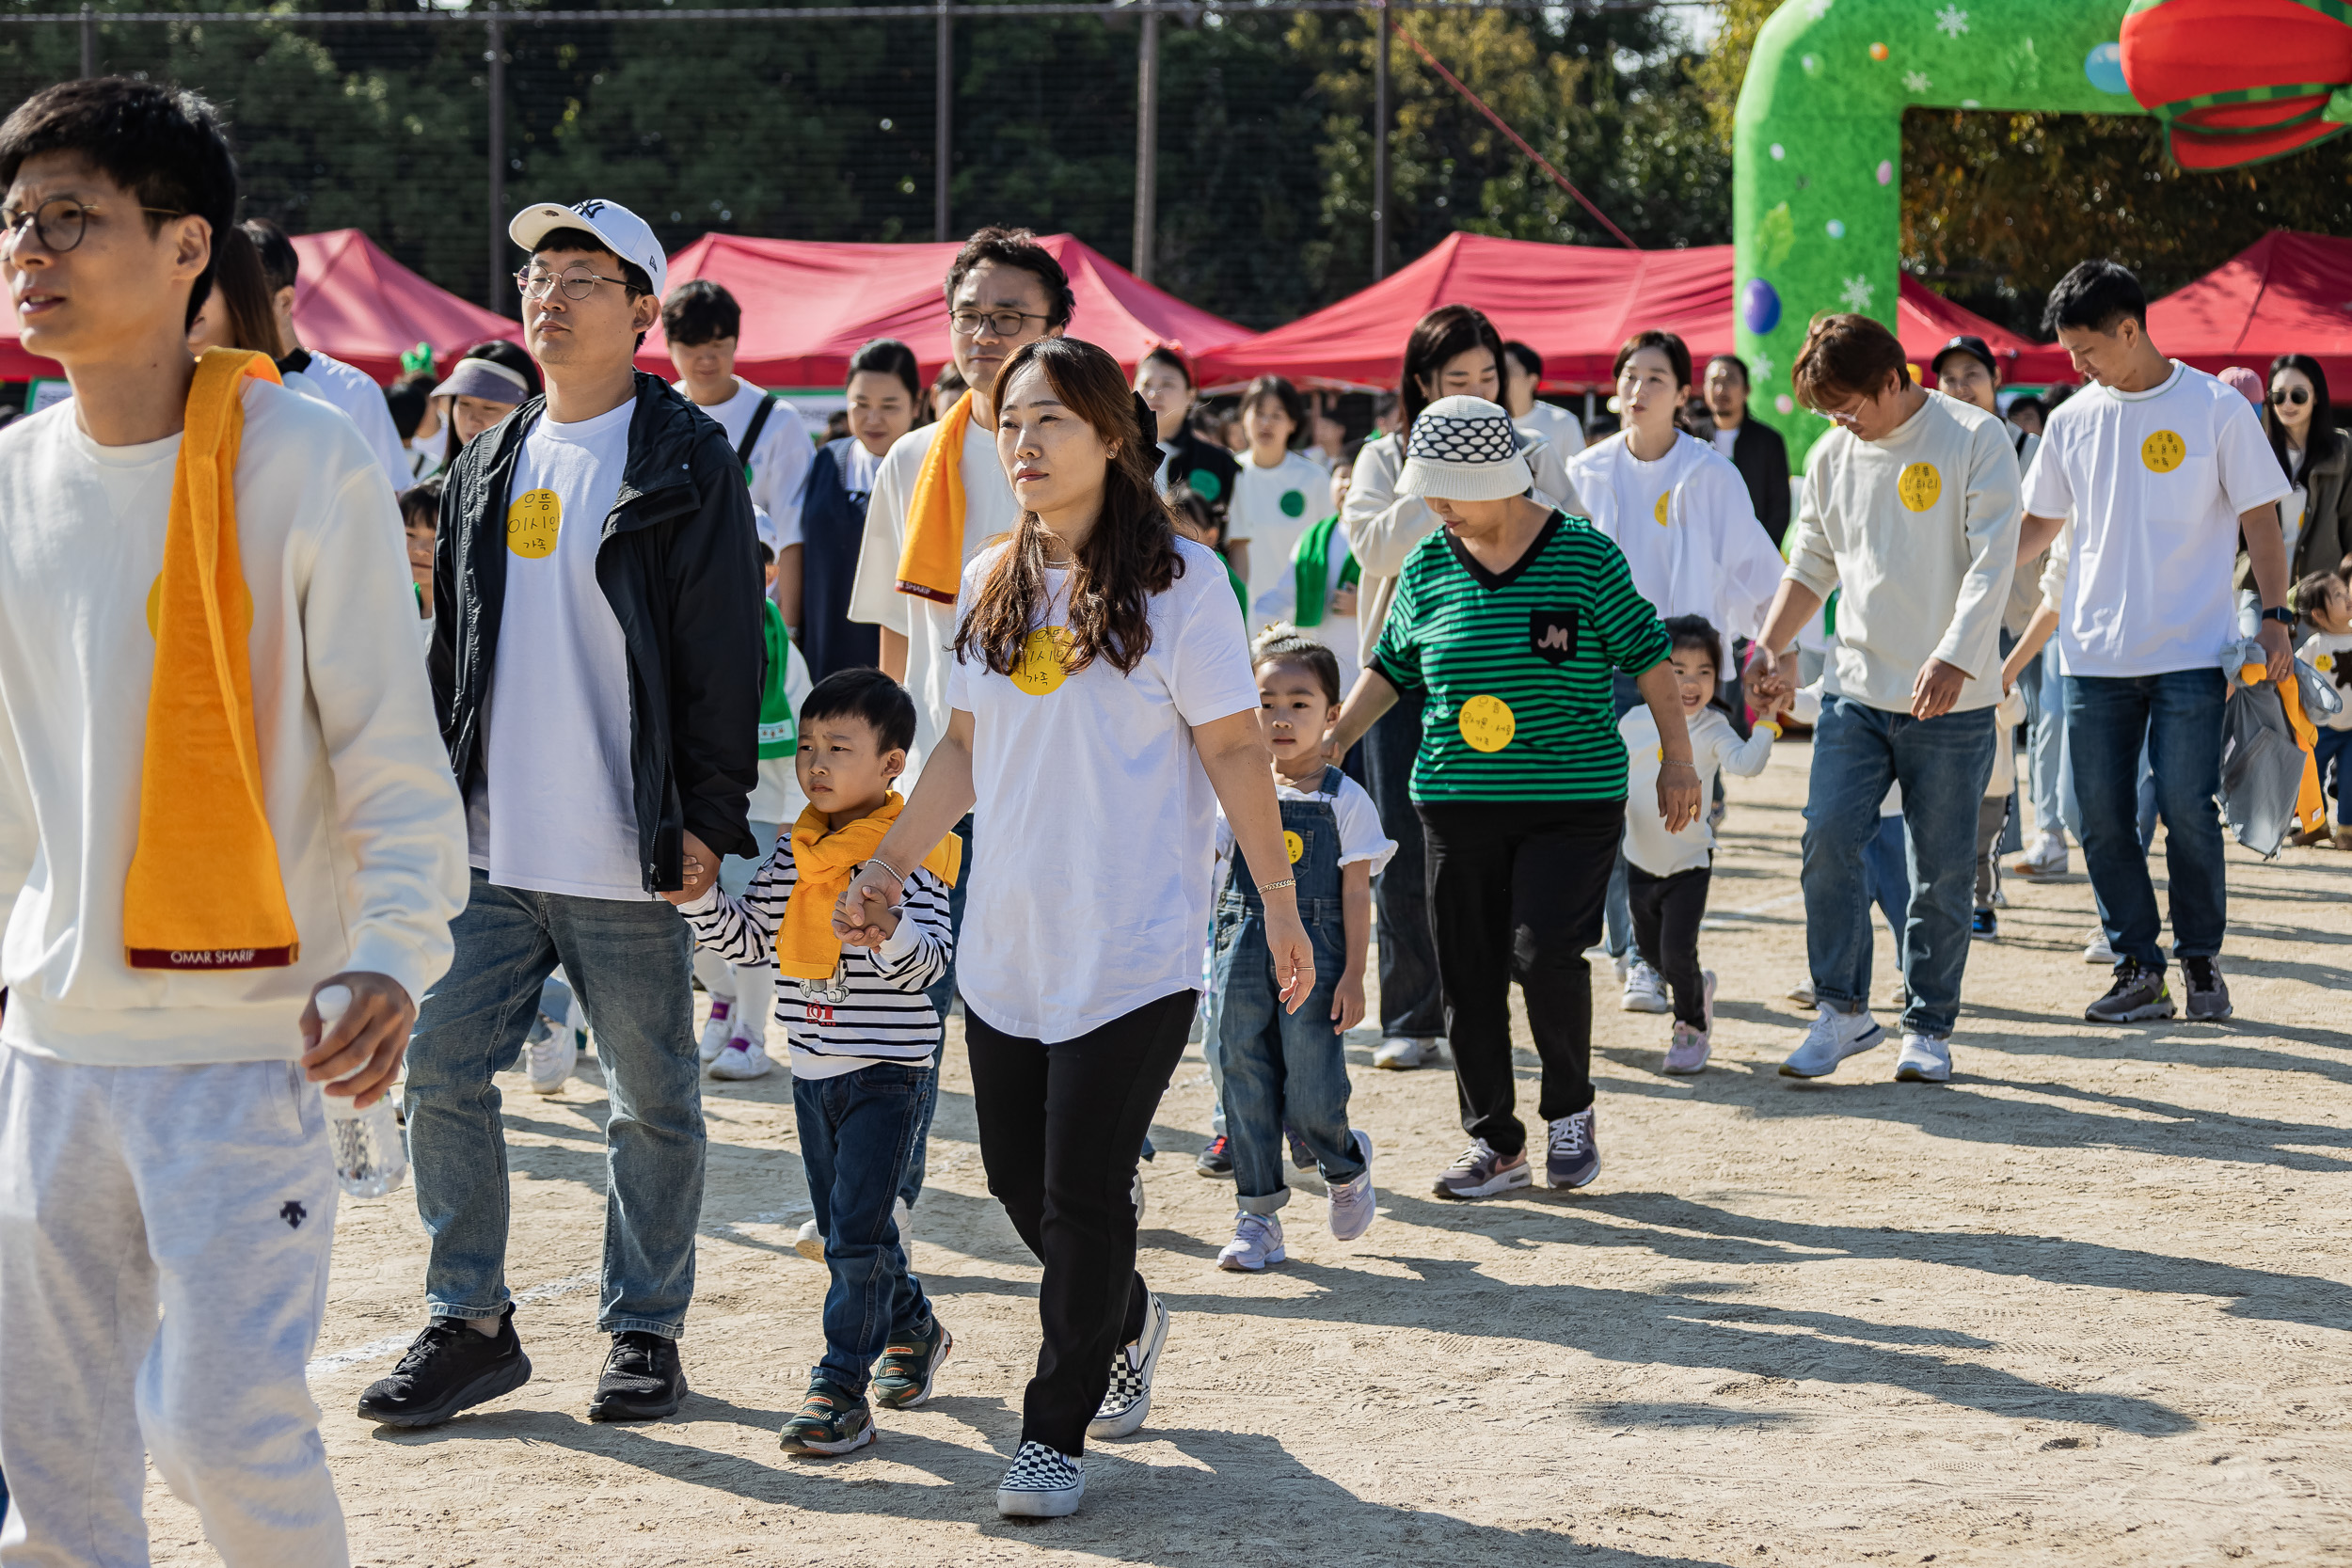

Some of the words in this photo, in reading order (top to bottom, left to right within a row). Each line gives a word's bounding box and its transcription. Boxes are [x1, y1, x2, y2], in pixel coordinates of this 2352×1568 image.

[524, 493, 551, 511] 으뜸
[508, 513, 560, 533] 이시안
[522, 538, 547, 551] 가족
[1026, 672, 1048, 686] 가족
[170, 951, 213, 964] OMAR
[215, 949, 256, 964] SHARIF
[806, 1004, 834, 1020] 101
